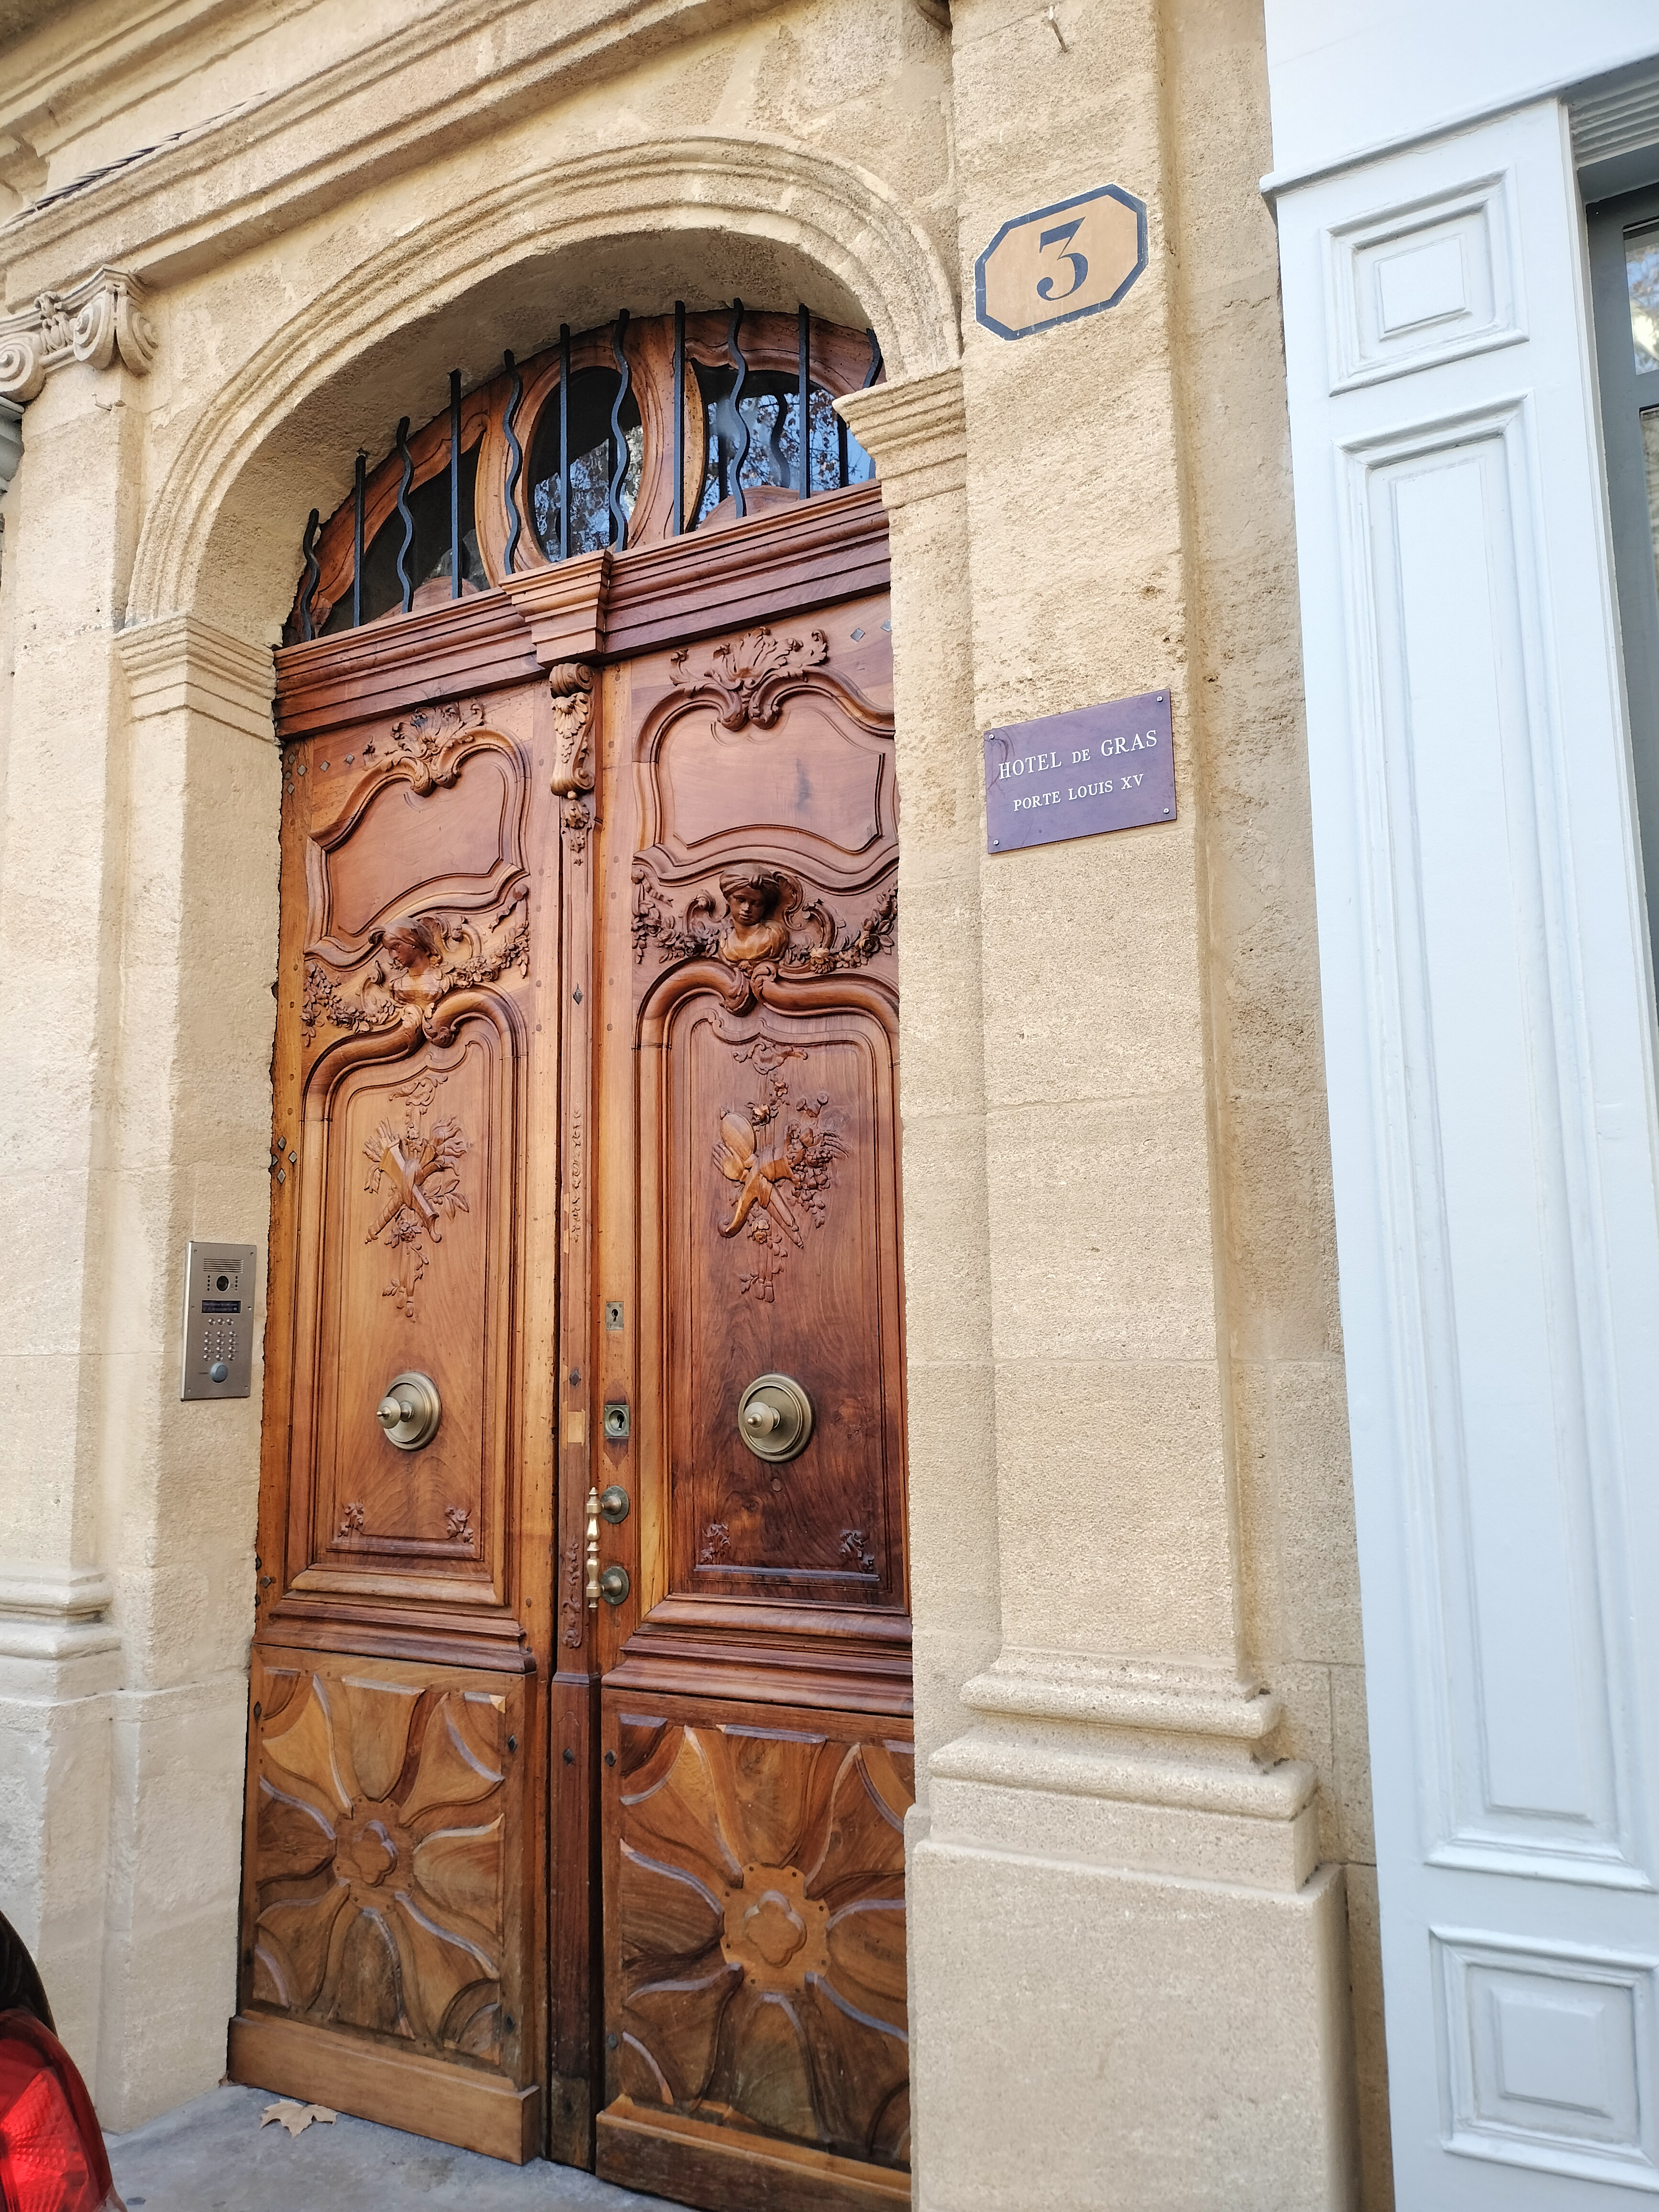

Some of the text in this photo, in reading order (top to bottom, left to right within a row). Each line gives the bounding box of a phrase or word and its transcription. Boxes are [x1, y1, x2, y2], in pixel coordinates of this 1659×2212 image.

[1037, 216, 1088, 301] 3
[998, 730, 1157, 779] HOTEL DE GRAS
[1013, 774, 1144, 811] PORTE LOUIS XV
